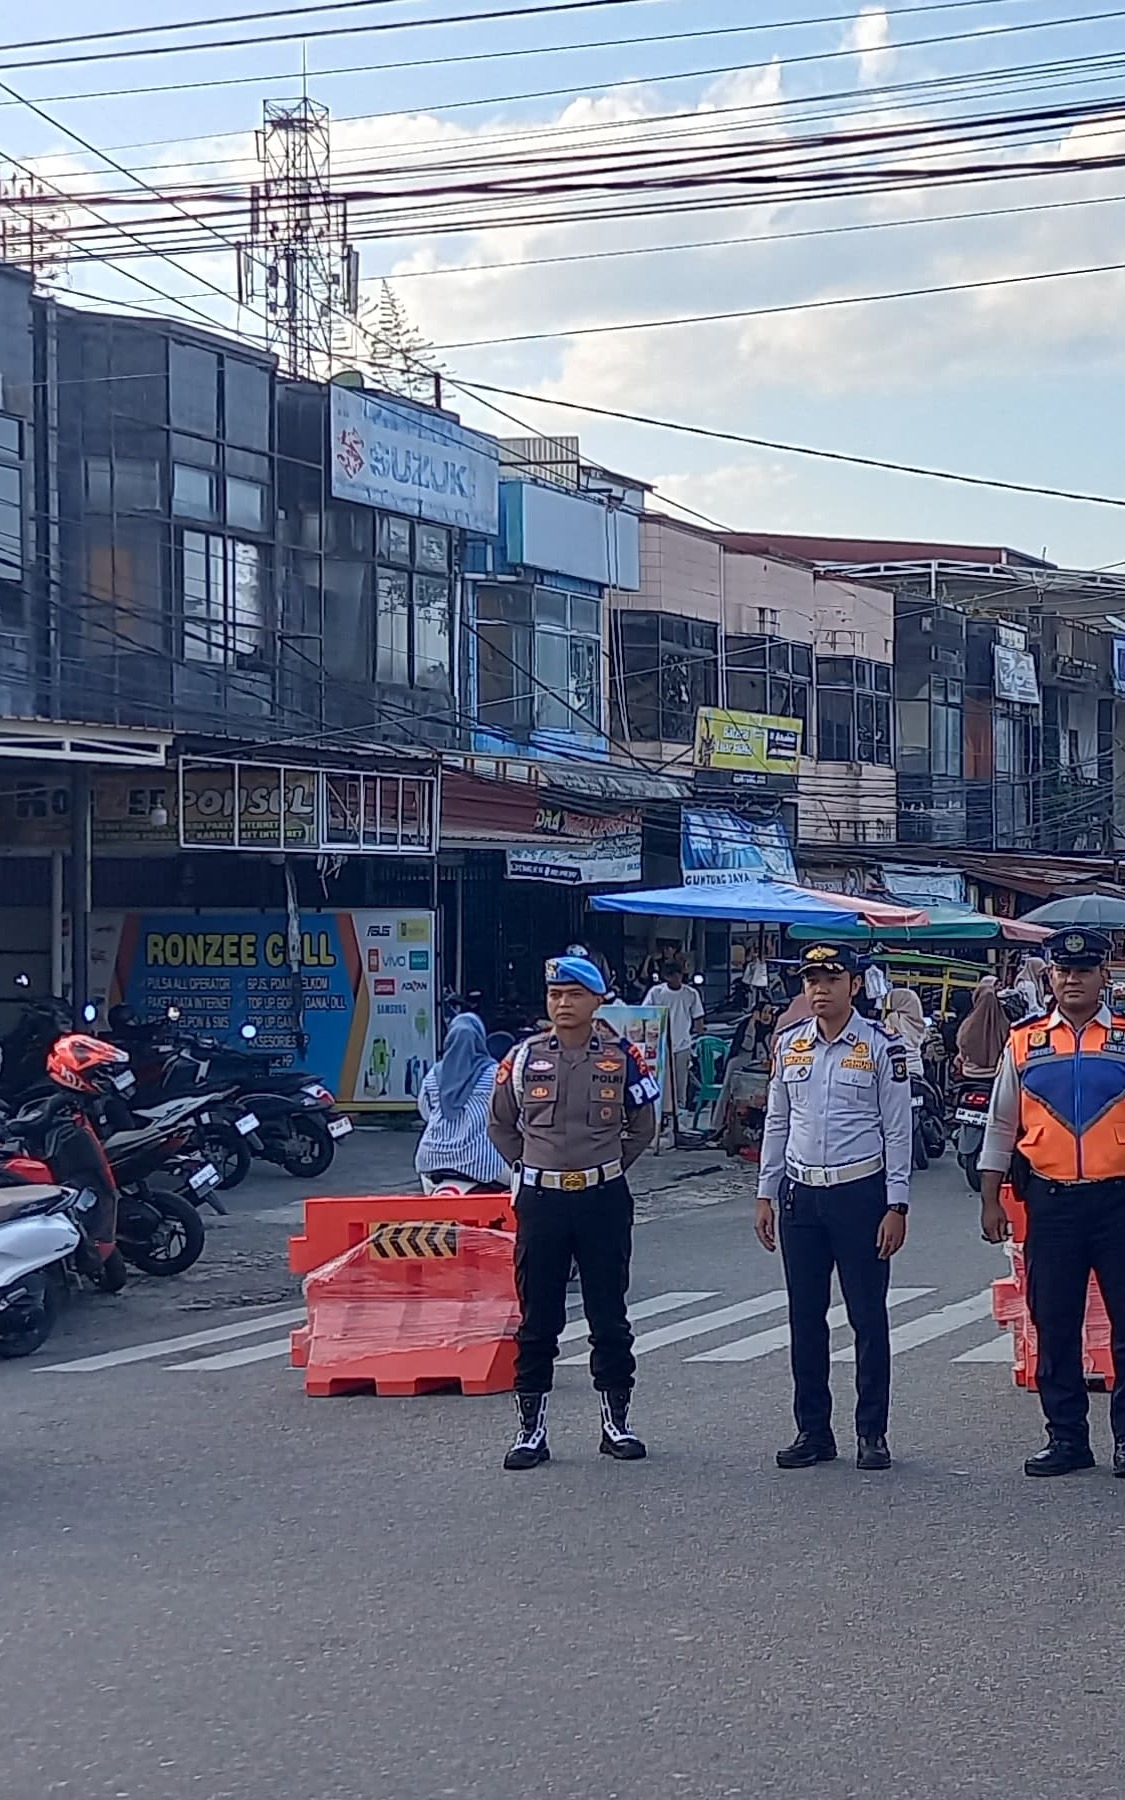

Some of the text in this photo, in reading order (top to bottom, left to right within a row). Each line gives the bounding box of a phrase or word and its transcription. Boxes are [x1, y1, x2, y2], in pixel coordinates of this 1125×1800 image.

[366, 925, 392, 937] ASUS
[146, 933, 257, 968] RONZEE
[265, 933, 336, 967] CLL
[190, 977, 232, 991] OPERATOR
[300, 977, 329, 990] ELKOM
[193, 996, 232, 1010] INTERNET
[177, 1015, 204, 1029] ELPON
[212, 1015, 230, 1029] SMS
[592, 1074, 624, 1084] POLRI
